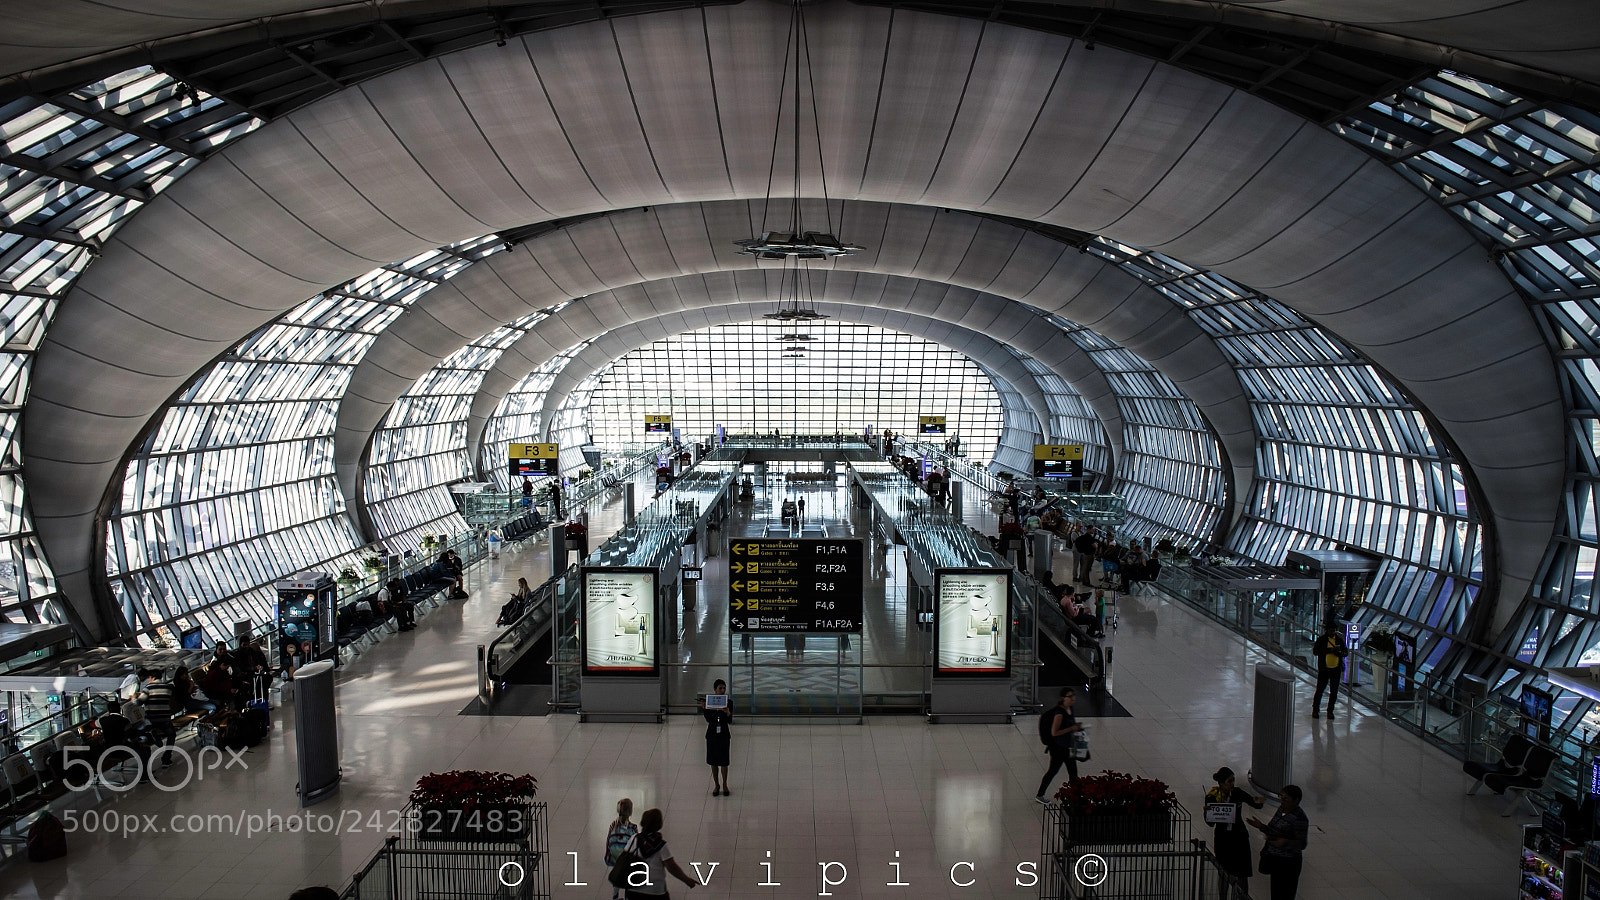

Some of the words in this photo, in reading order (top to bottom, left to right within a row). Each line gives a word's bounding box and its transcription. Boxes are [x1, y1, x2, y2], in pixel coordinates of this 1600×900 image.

[525, 445, 540, 456] F3
[1051, 447, 1066, 458] F4
[816, 545, 847, 554] F1,F1A
[815, 564, 847, 574] F2,F2A
[815, 582, 835, 592] F3,5
[815, 601, 835, 611] F4,6
[815, 619, 853, 629] F1A,F2A
